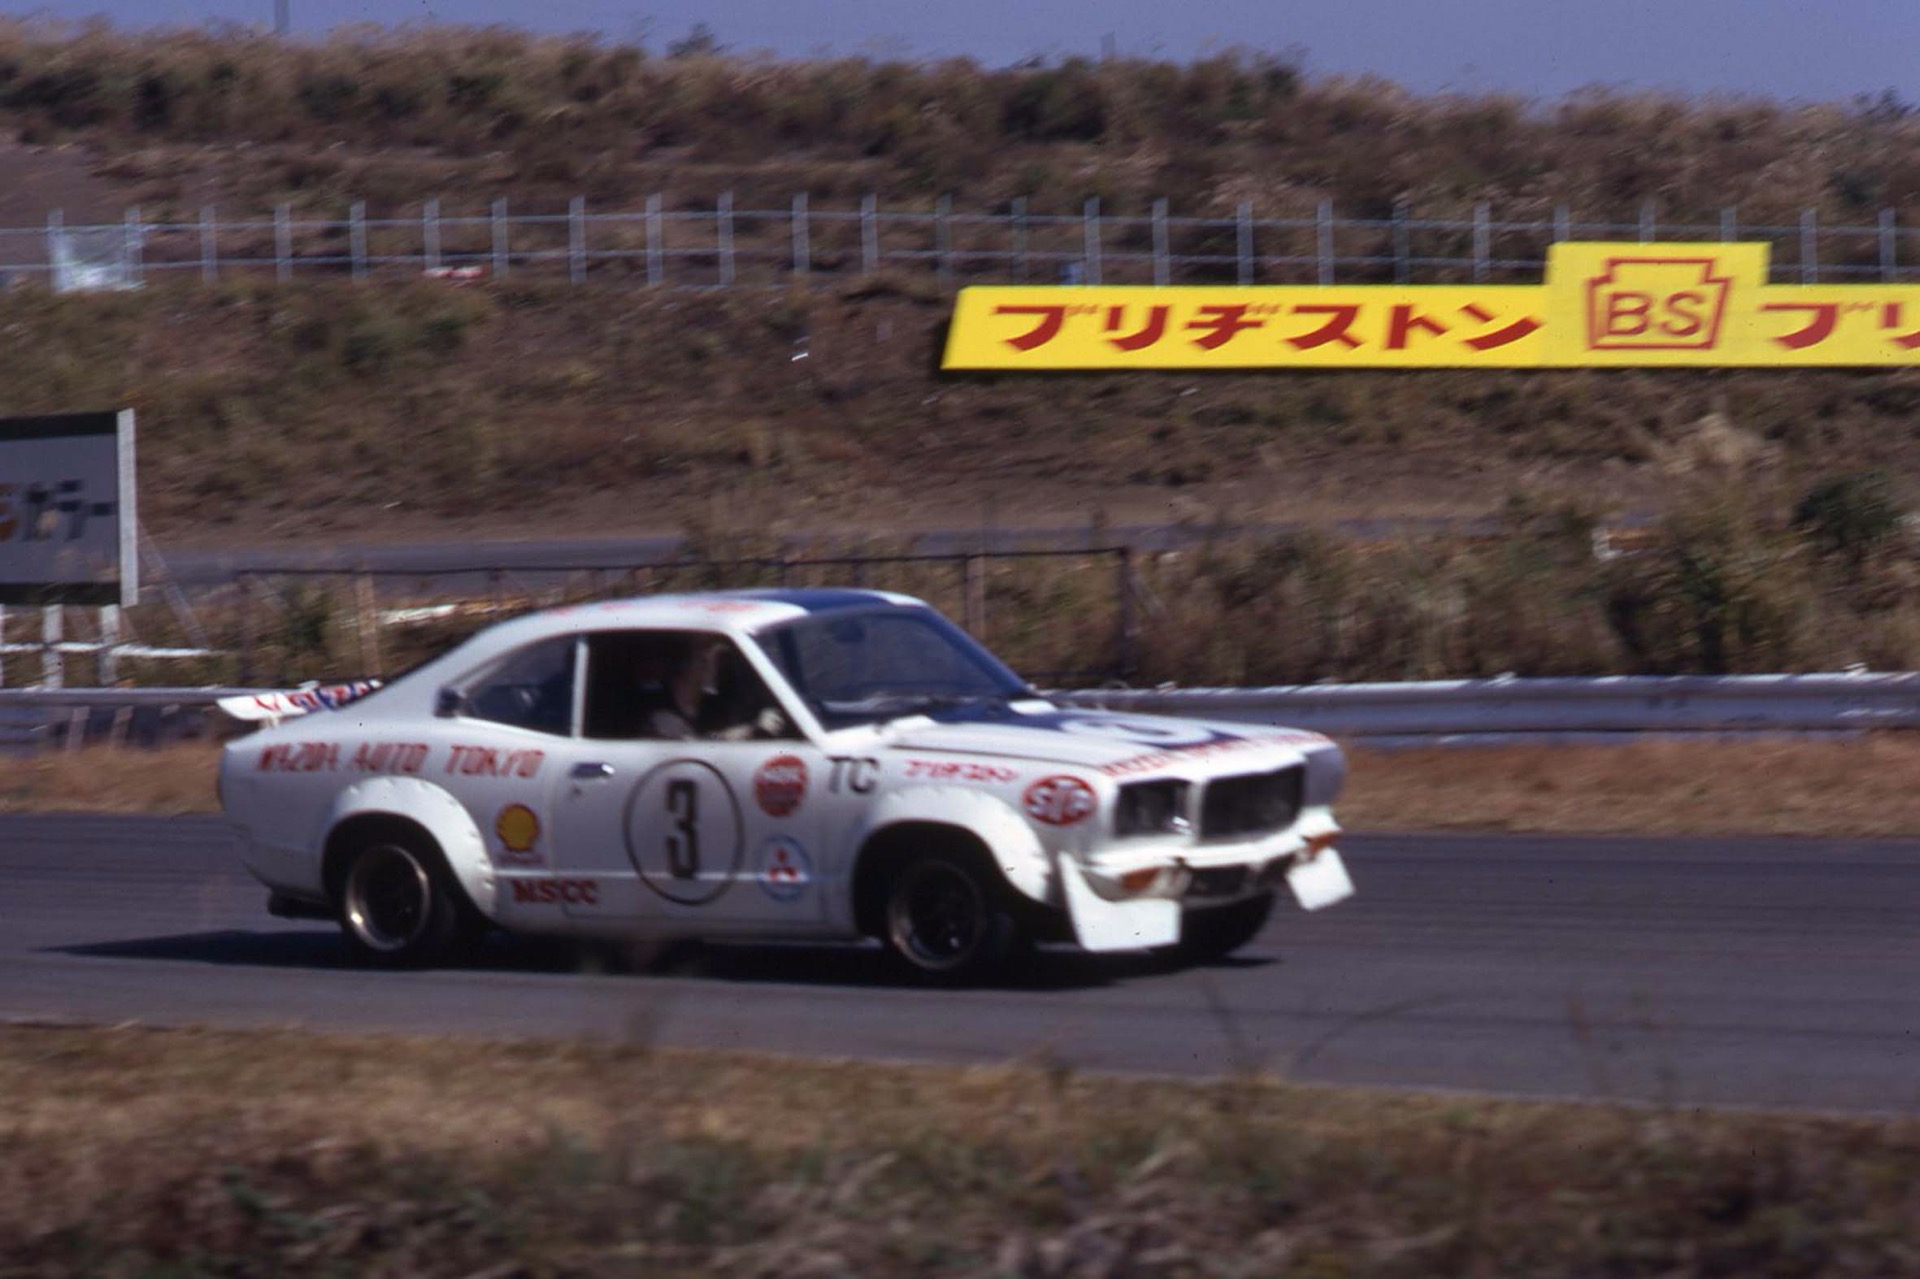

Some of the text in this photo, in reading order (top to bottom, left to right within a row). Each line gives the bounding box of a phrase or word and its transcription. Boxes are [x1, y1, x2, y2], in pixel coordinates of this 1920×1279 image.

[992, 303, 1543, 351] ブリヂストン
[1605, 292, 1712, 337] BS
[351, 742, 430, 773] AUTO
[444, 745, 545, 779] TOKYO
[827, 756, 881, 793] TC
[1028, 778, 1095, 820] STP
[665, 779, 699, 880] 3
[510, 877, 598, 904] MSCC
